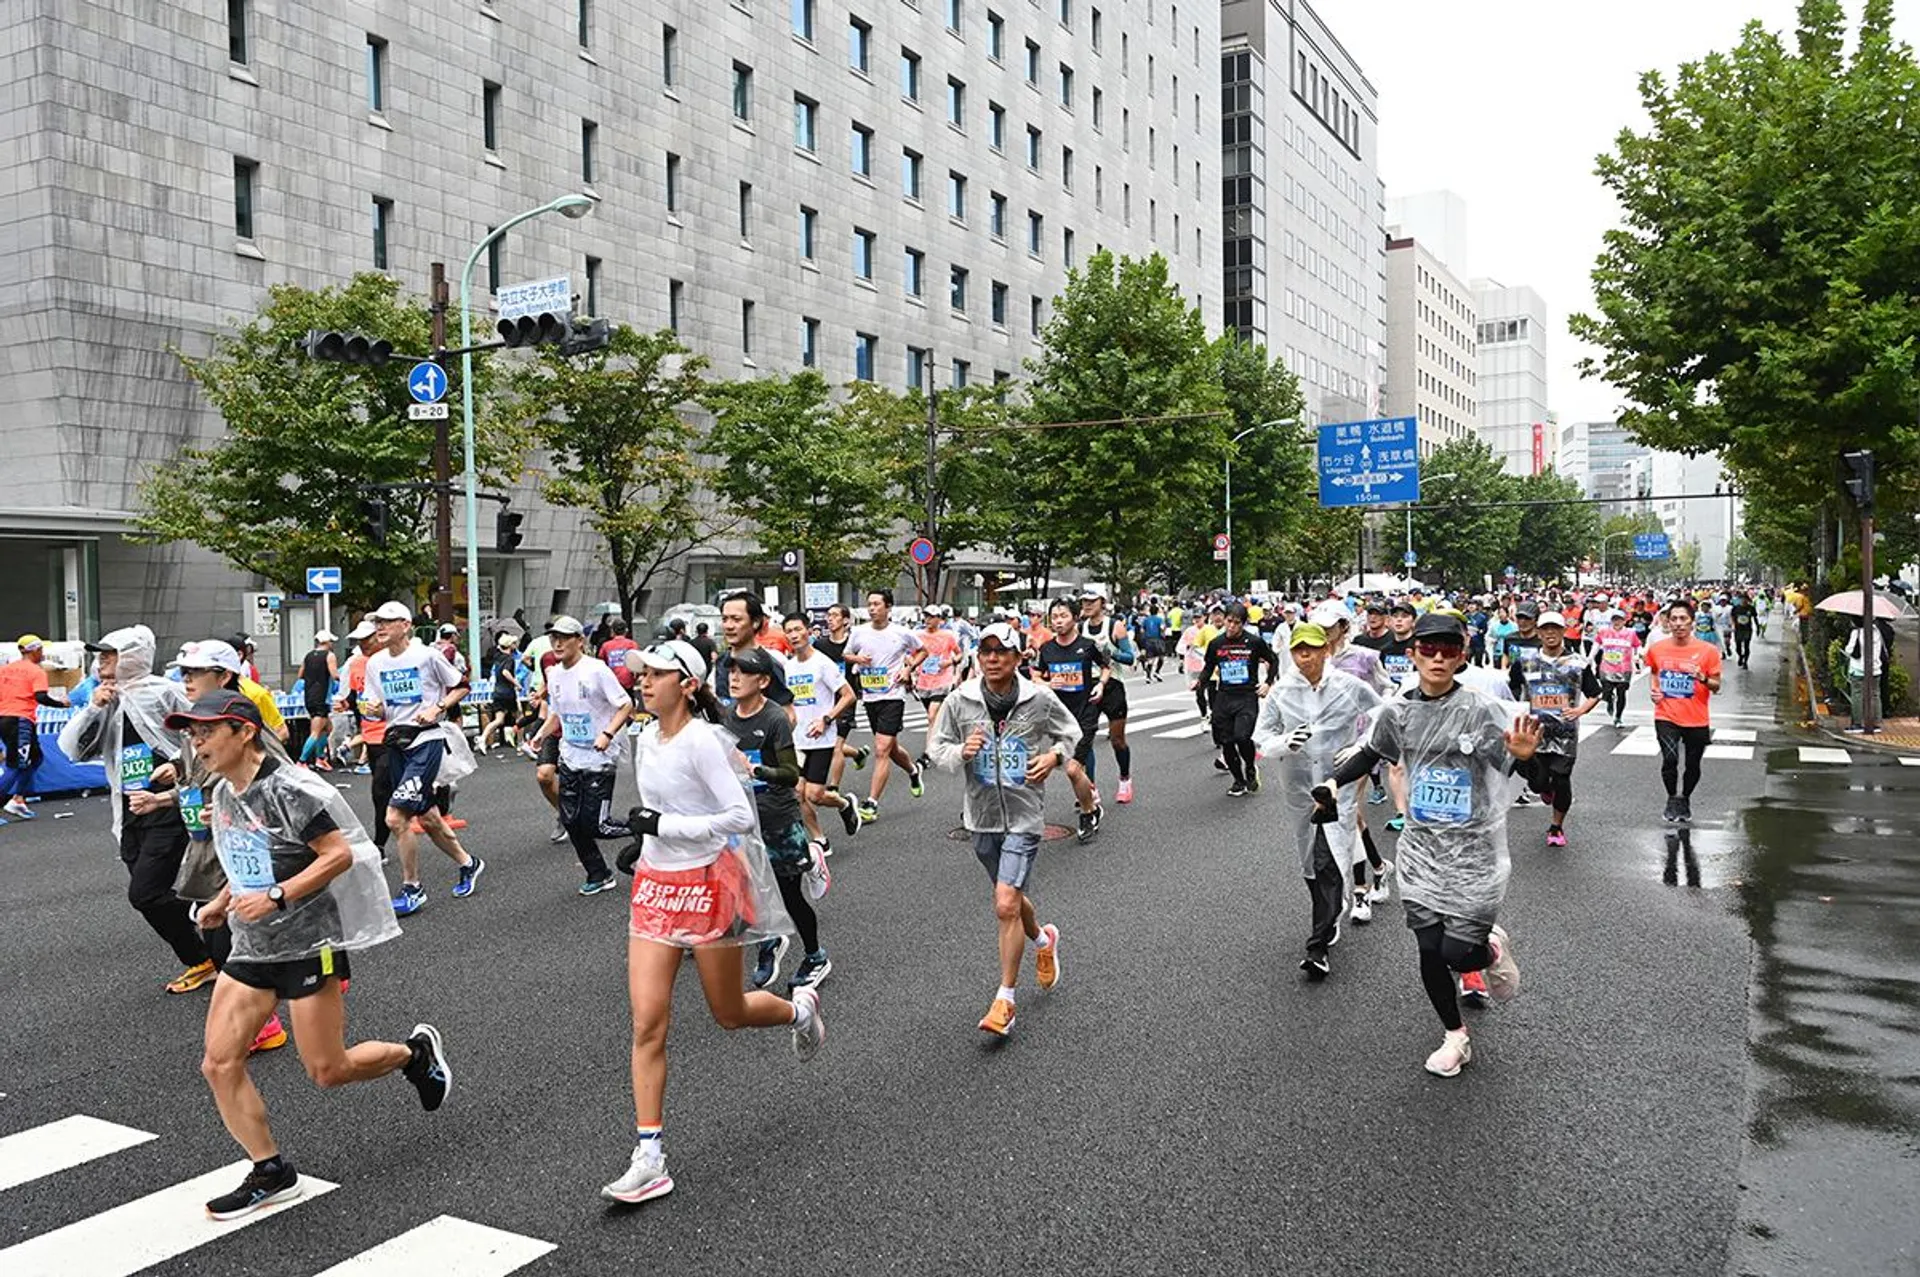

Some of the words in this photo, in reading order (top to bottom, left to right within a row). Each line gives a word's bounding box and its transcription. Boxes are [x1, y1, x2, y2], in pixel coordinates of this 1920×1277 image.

[500, 279, 567, 306] 共立女子大学前
[414, 407, 443, 417] 8-20
[1355, 493, 1381, 502] 150m
[394, 670, 411, 680] Sky
[1061, 663, 1077, 673] Sky
[123, 747, 143, 760] Sky
[983, 753, 1020, 769] 1559
[1431, 769, 1460, 786] Sky
[1421, 783, 1462, 804] 17377
[231, 834, 254, 851] Sky
[231, 854, 261, 875] 5733
[631, 891, 714, 914] RUNNING
